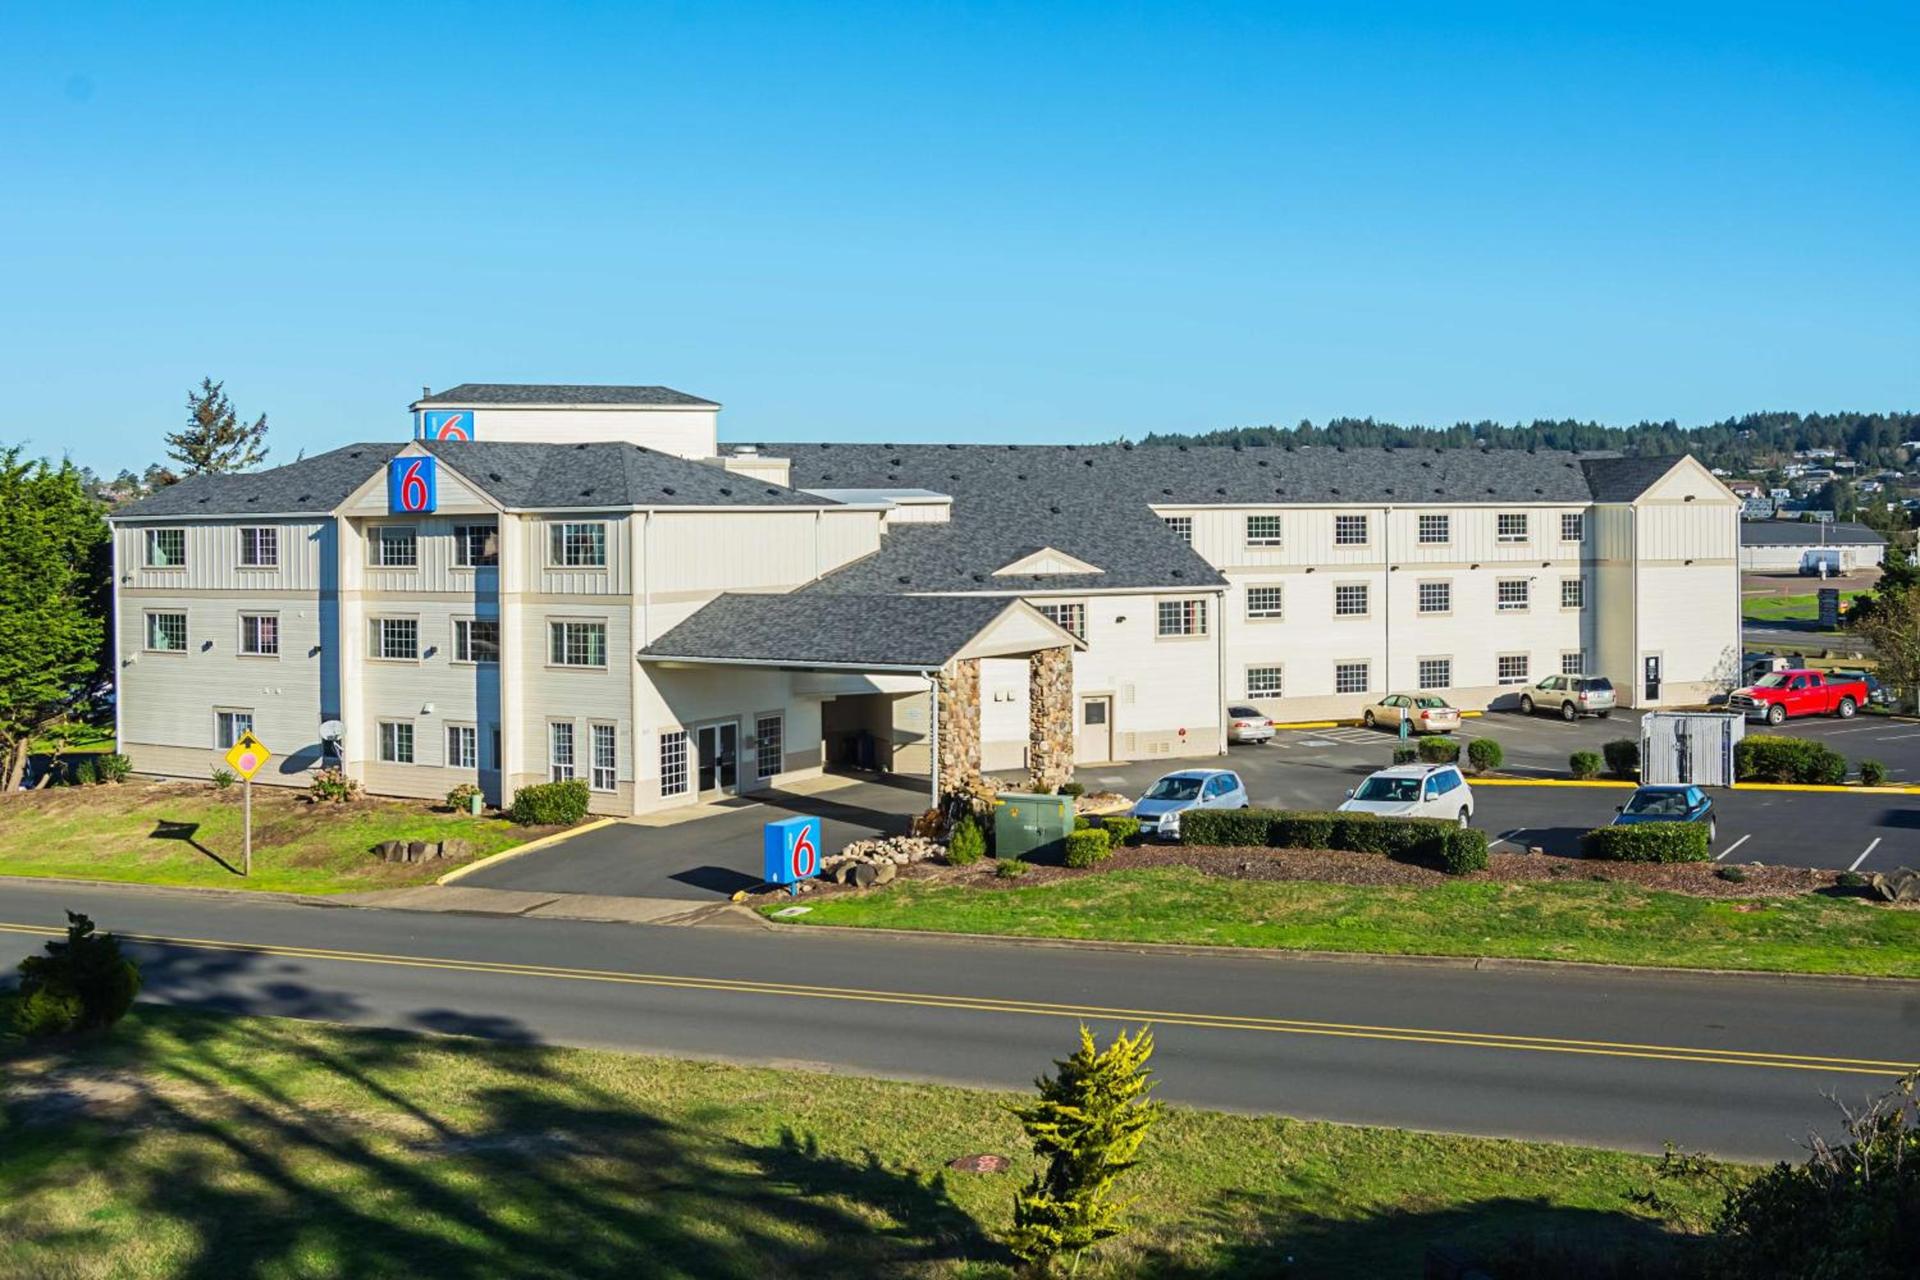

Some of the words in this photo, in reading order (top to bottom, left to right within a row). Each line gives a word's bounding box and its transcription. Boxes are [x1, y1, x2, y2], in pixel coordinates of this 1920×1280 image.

[438, 415, 468, 441] 6
[402, 461, 428, 511] 6
[792, 825, 815, 878] 6
